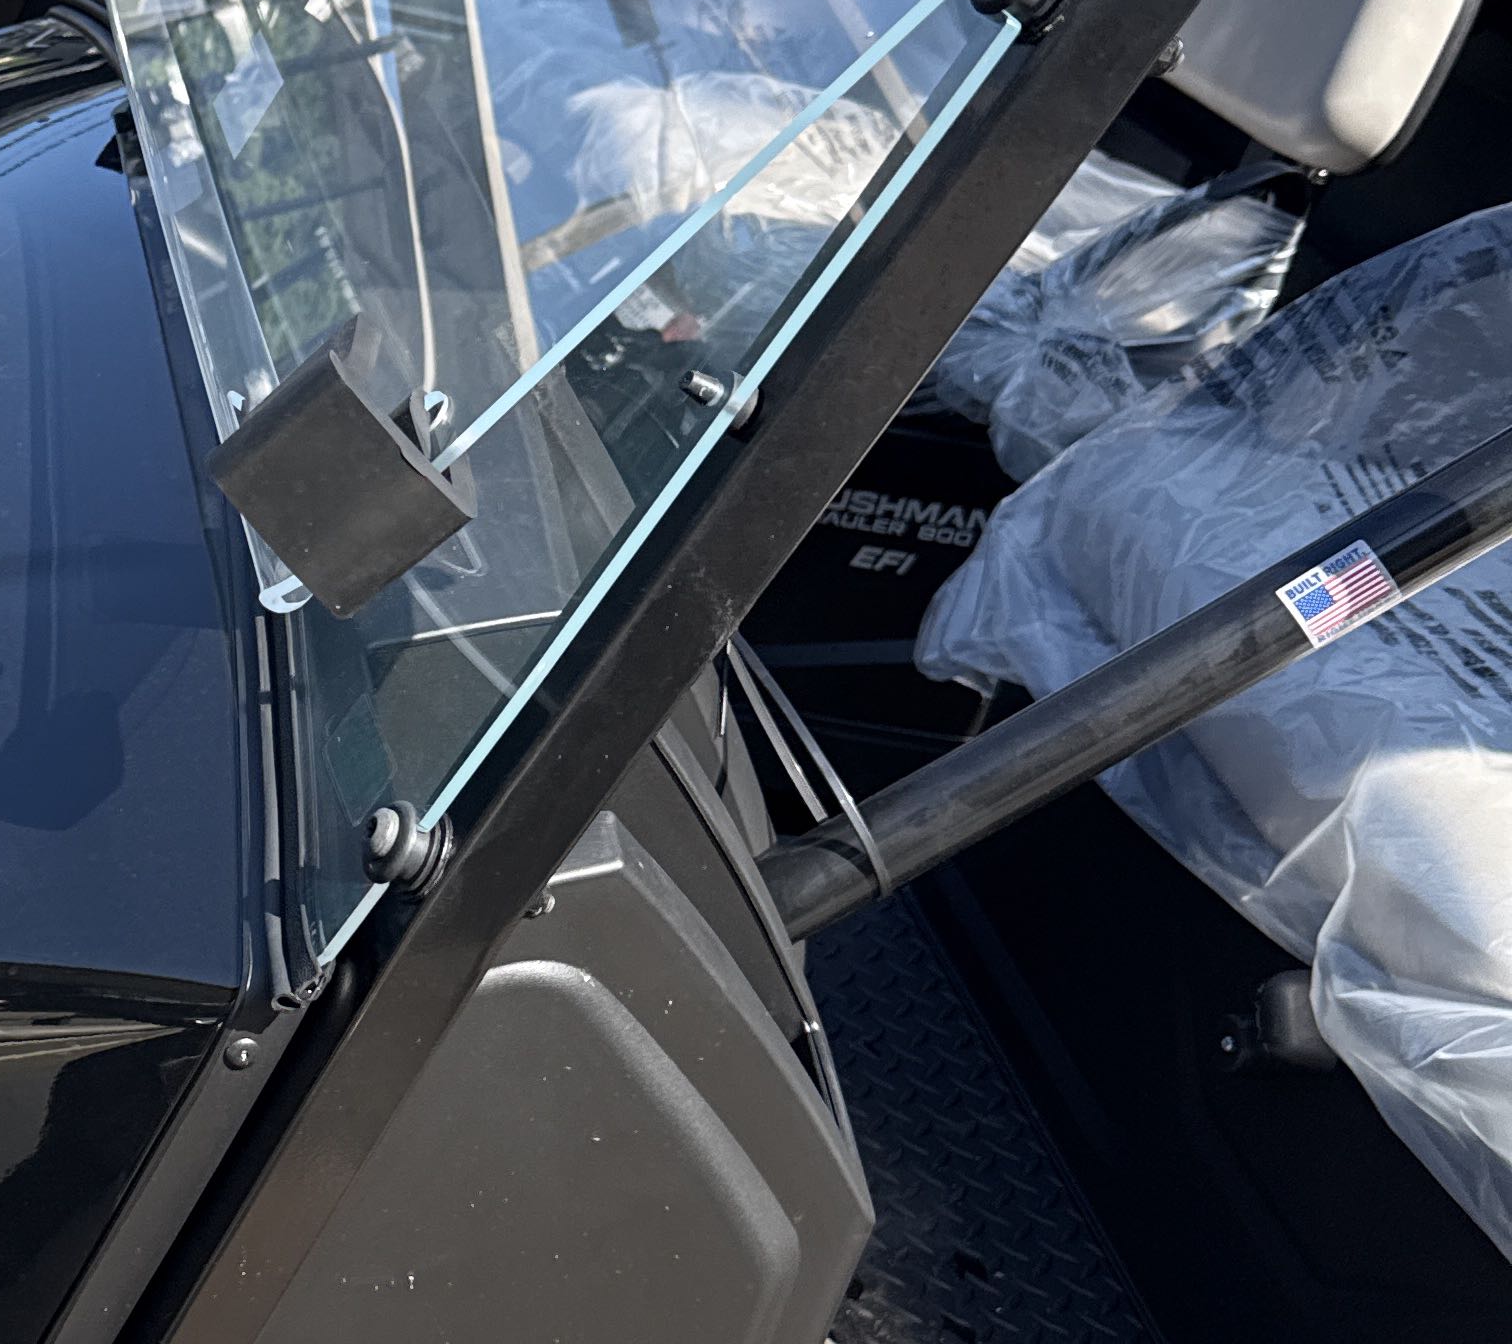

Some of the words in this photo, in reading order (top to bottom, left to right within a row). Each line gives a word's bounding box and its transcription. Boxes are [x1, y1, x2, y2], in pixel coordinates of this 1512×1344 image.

[821, 512, 906, 536] AULER
[827, 489, 988, 530] USHMAN
[850, 545, 916, 575] EFI
[1284, 571, 1323, 600] BUILT
